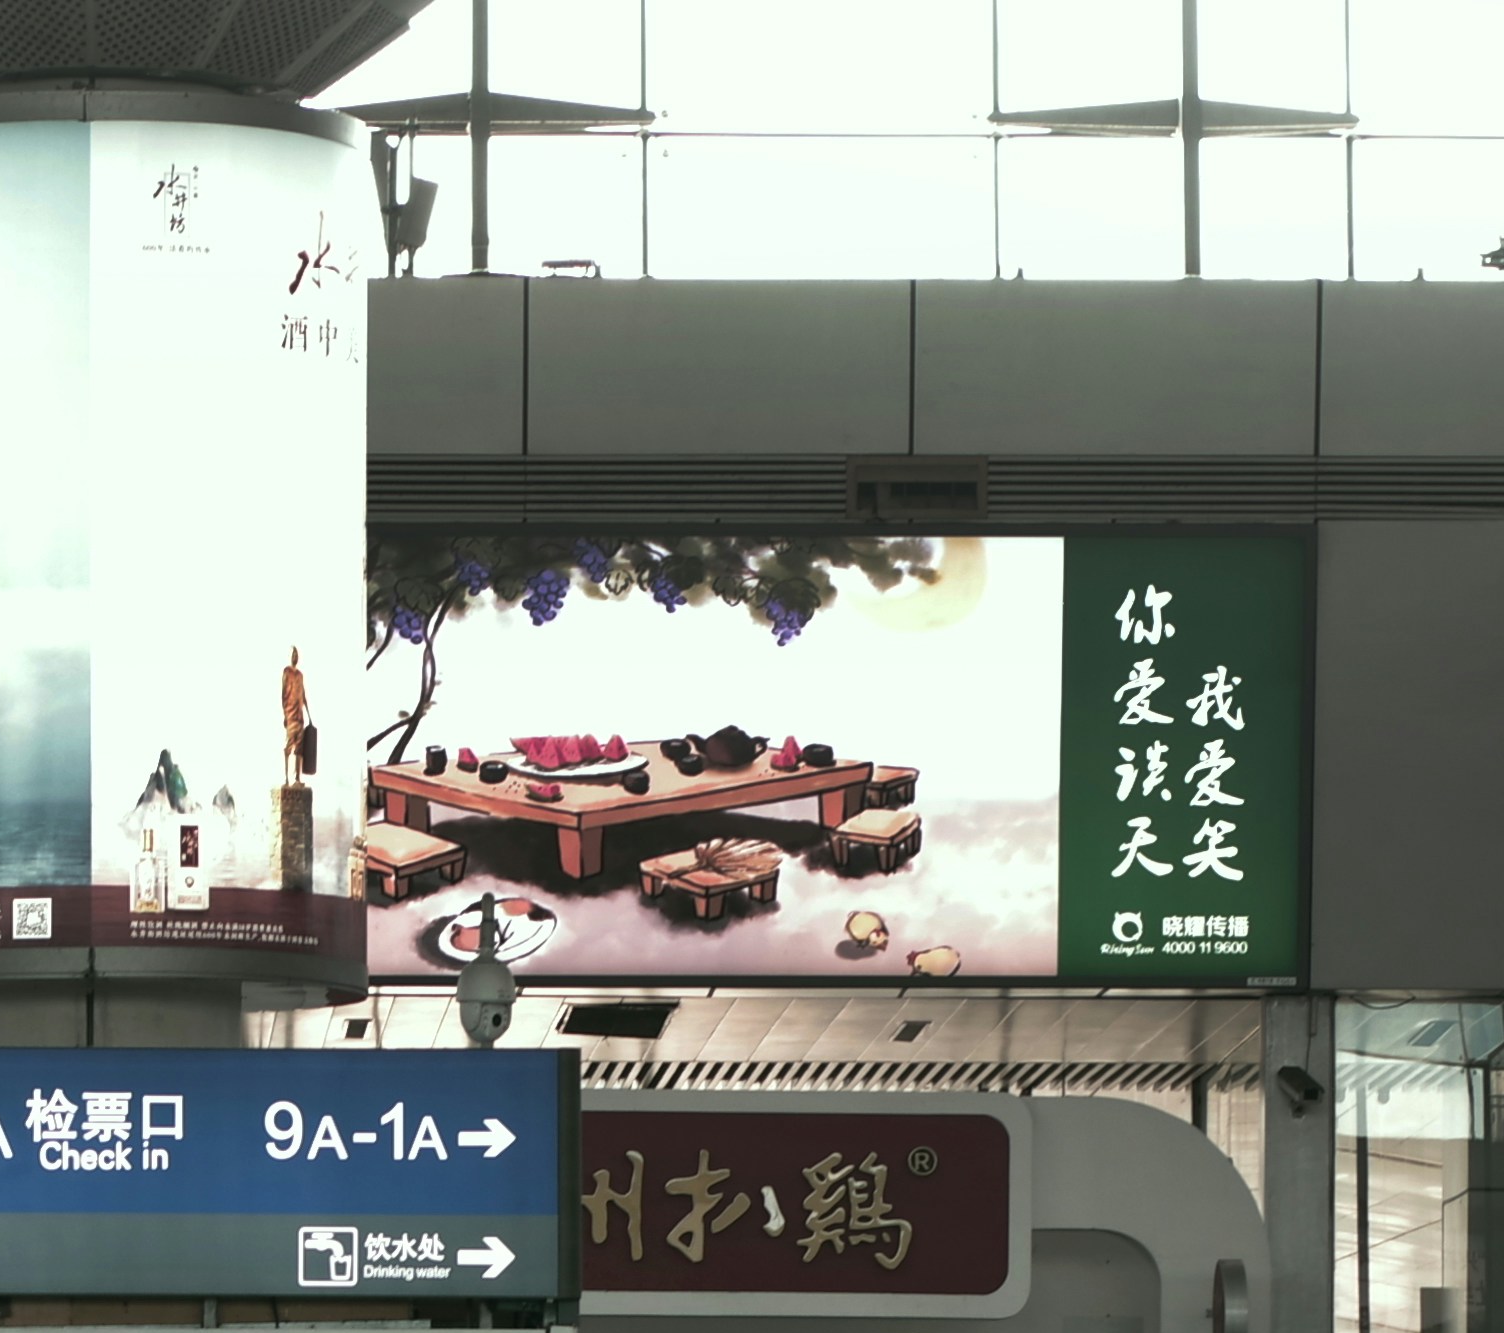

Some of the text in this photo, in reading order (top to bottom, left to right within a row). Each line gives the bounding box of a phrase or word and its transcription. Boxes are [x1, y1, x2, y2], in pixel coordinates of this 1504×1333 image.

[1111, 584, 1176, 880] 你爱谈天
[1182, 664, 1247, 882] 我爱笑
[1162, 915, 1250, 938] 晓耀传播
[25, 1088, 185, 1143] 检票口
[263, 1101, 449, 1162] 9A-1A
[38, 1141, 169, 1172] Check in
[363, 1233, 446, 1264] 饮水处
[363, 1264, 452, 1282] Drinking water
